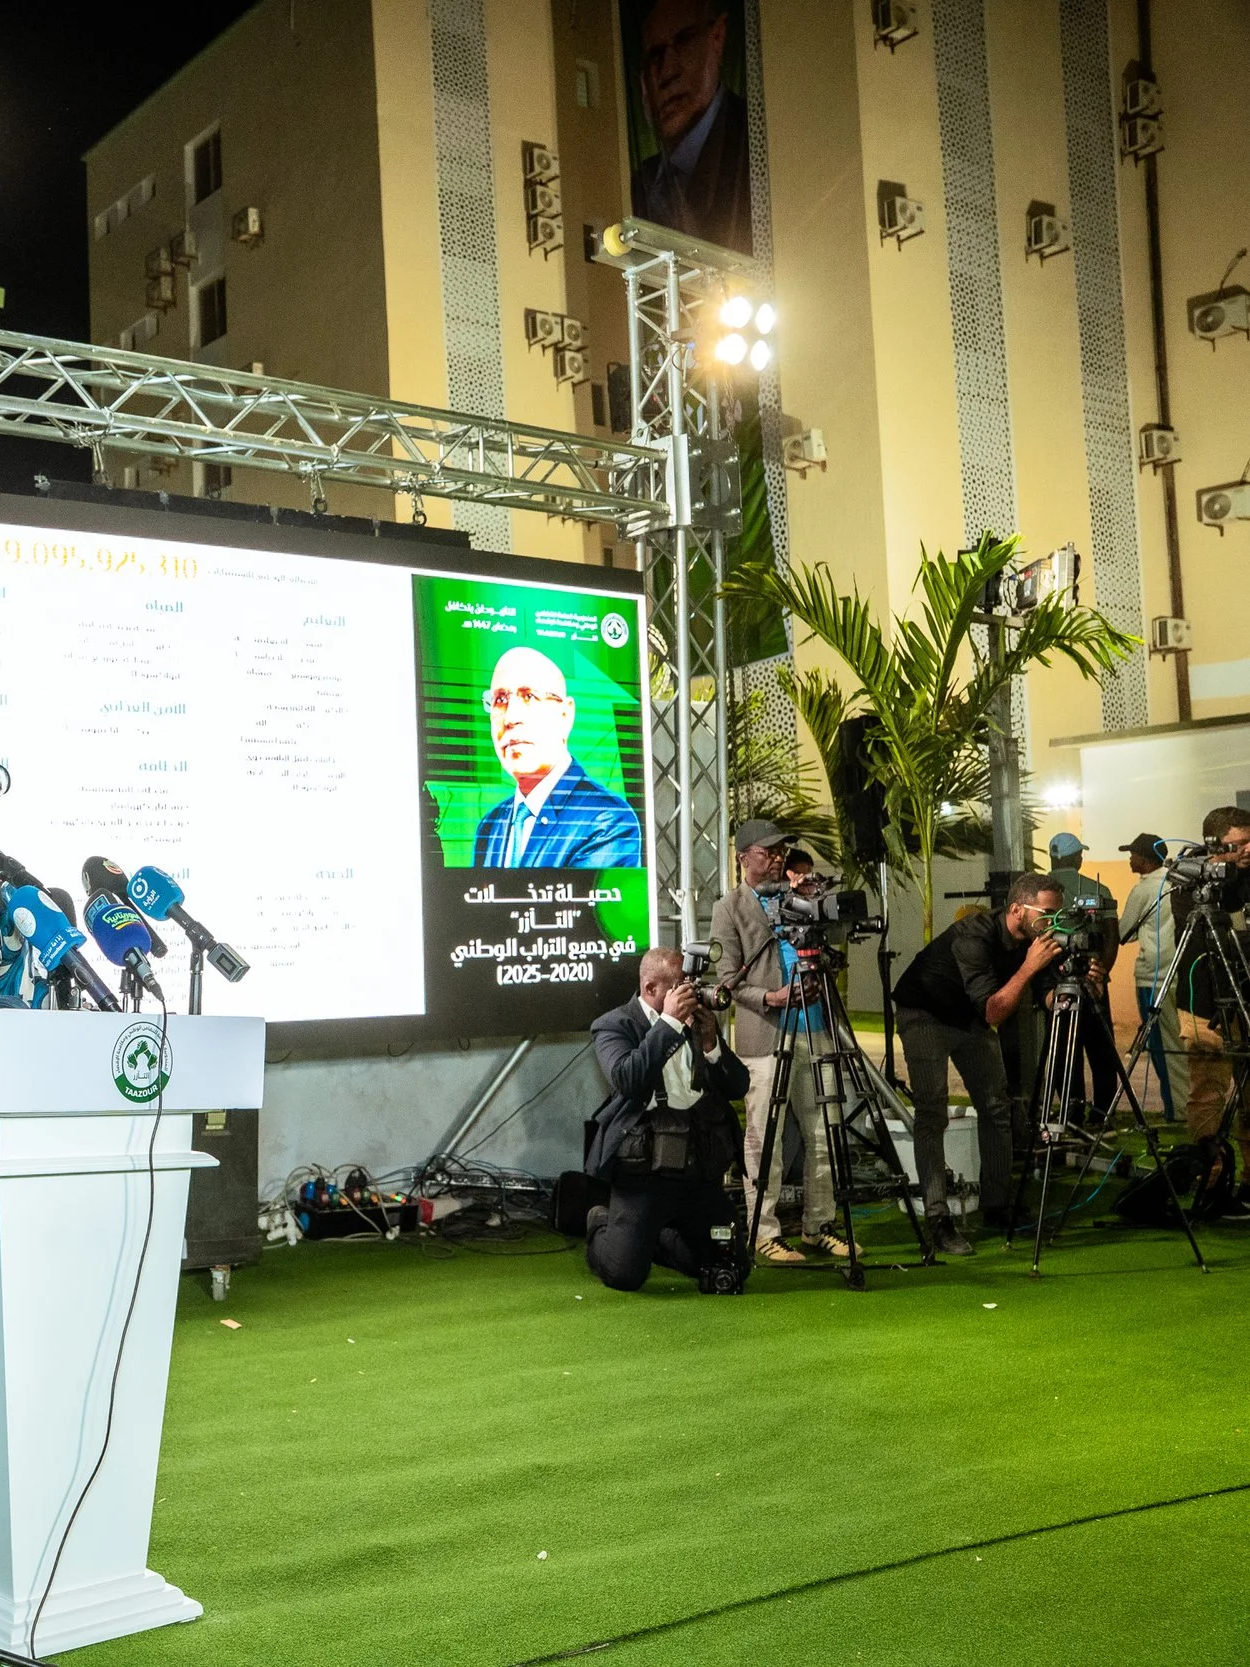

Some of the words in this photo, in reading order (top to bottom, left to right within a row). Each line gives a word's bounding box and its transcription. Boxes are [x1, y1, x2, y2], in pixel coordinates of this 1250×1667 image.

[450, 937, 518, 967] الوطني
[519, 936, 567, 961] التراب
[567, 941, 608, 963] جميع
[609, 935, 637, 961] في
[124, 1084, 159, 1098] TAAZOUR
